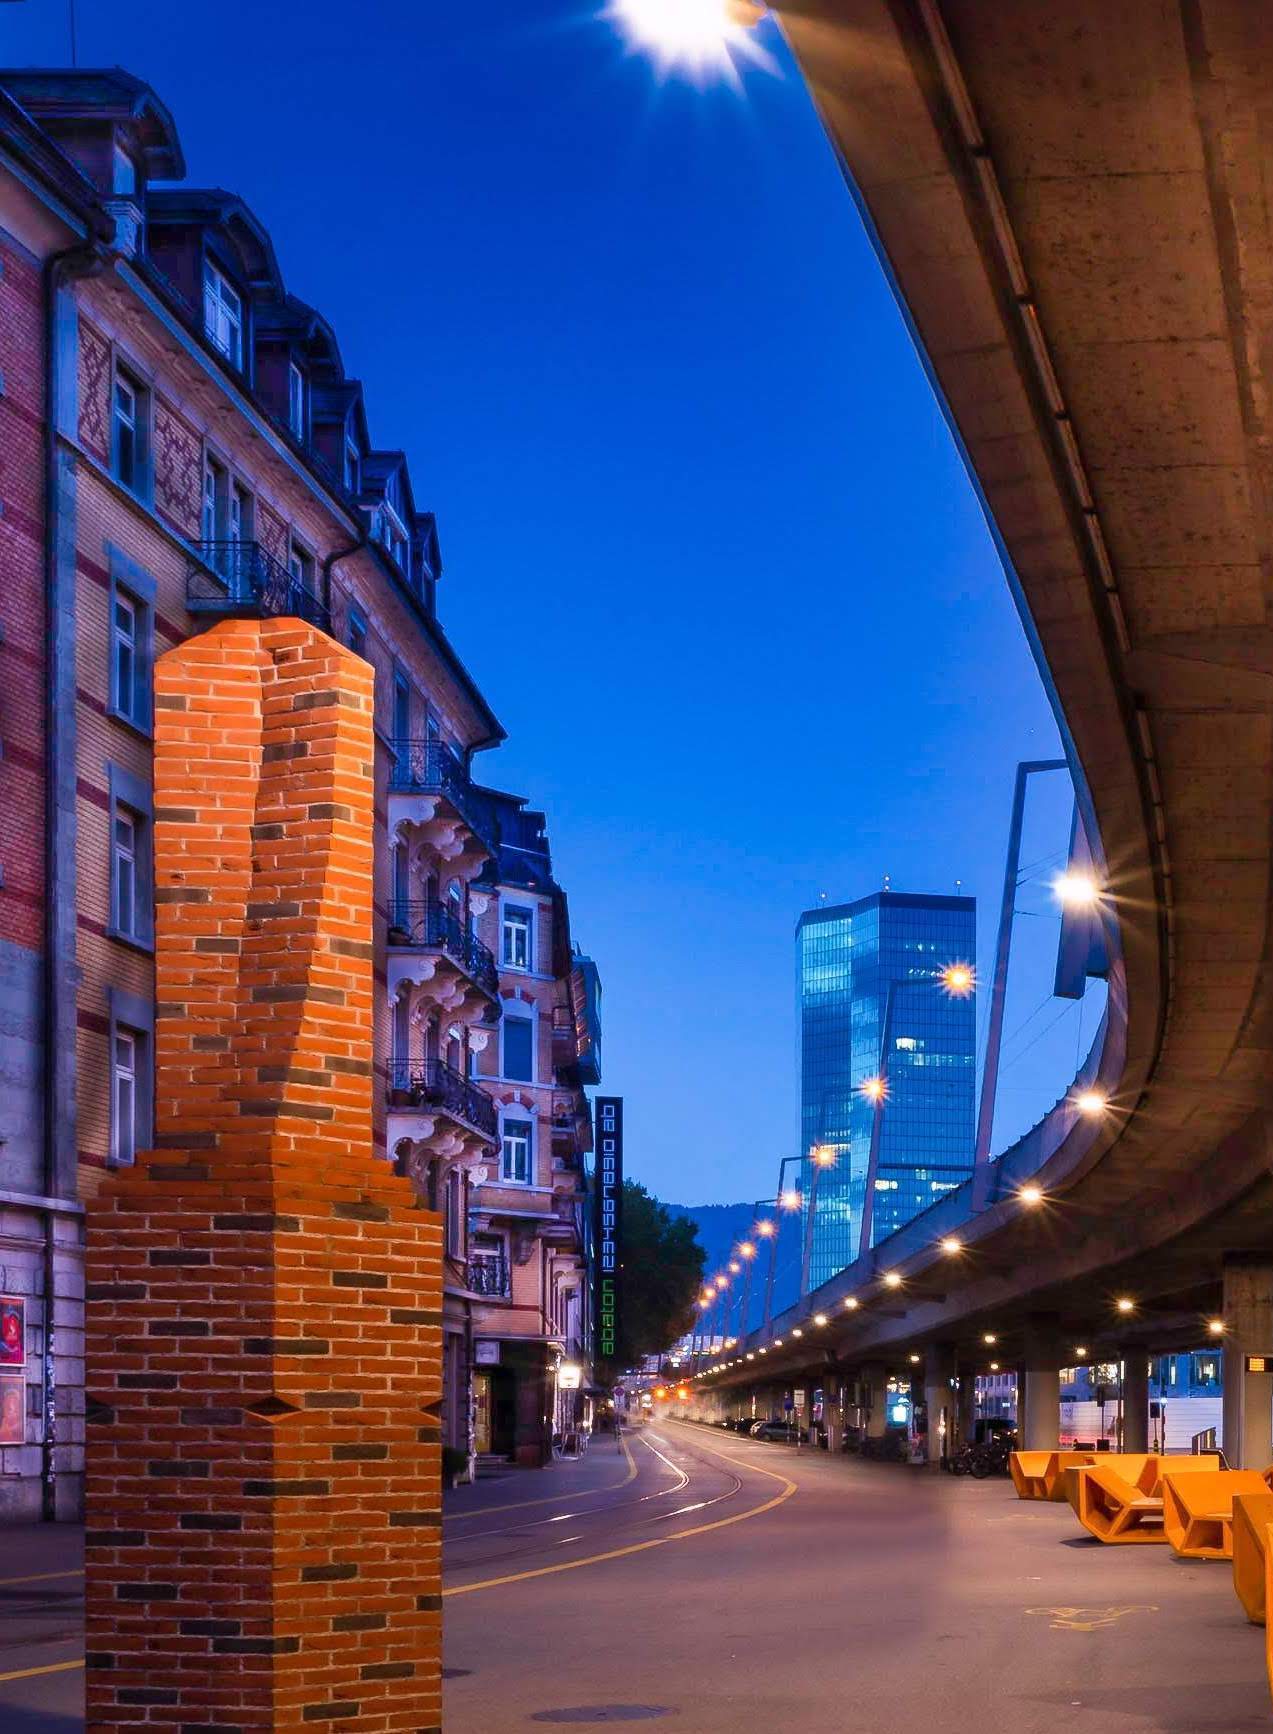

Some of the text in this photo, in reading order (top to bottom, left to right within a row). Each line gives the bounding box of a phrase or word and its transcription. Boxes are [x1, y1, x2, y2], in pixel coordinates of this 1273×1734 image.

[600, 1105, 615, 1355] abaton 12345678910 ab
